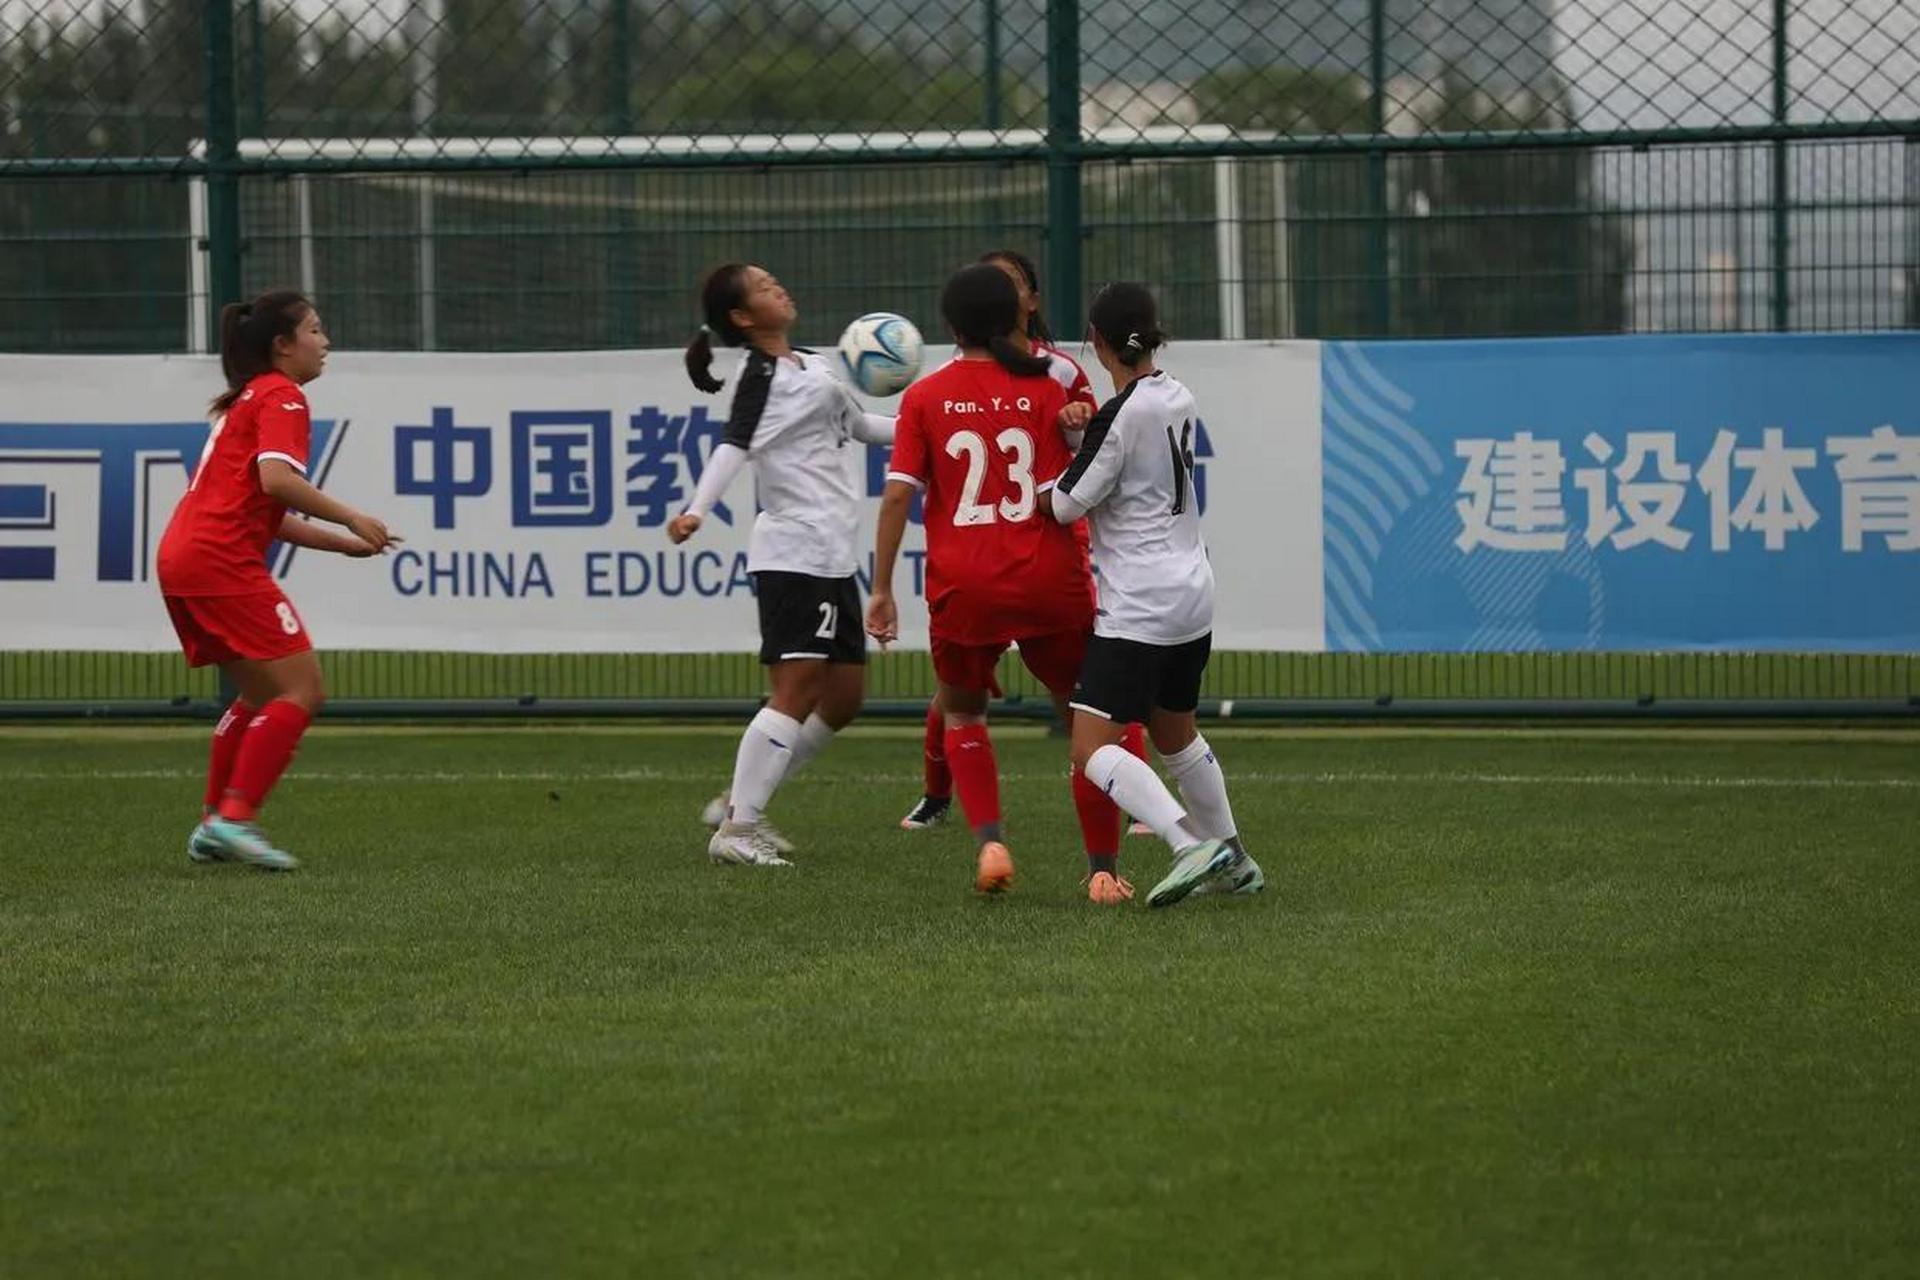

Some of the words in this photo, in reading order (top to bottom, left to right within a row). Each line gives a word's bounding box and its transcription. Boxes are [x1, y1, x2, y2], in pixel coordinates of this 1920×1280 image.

[944, 400, 984, 414] Pan.
[945, 427, 1036, 527] 23
[1454, 425, 1920, 554] 建设体育
[392, 550, 553, 598] CHINA
[275, 601, 299, 635] 8
